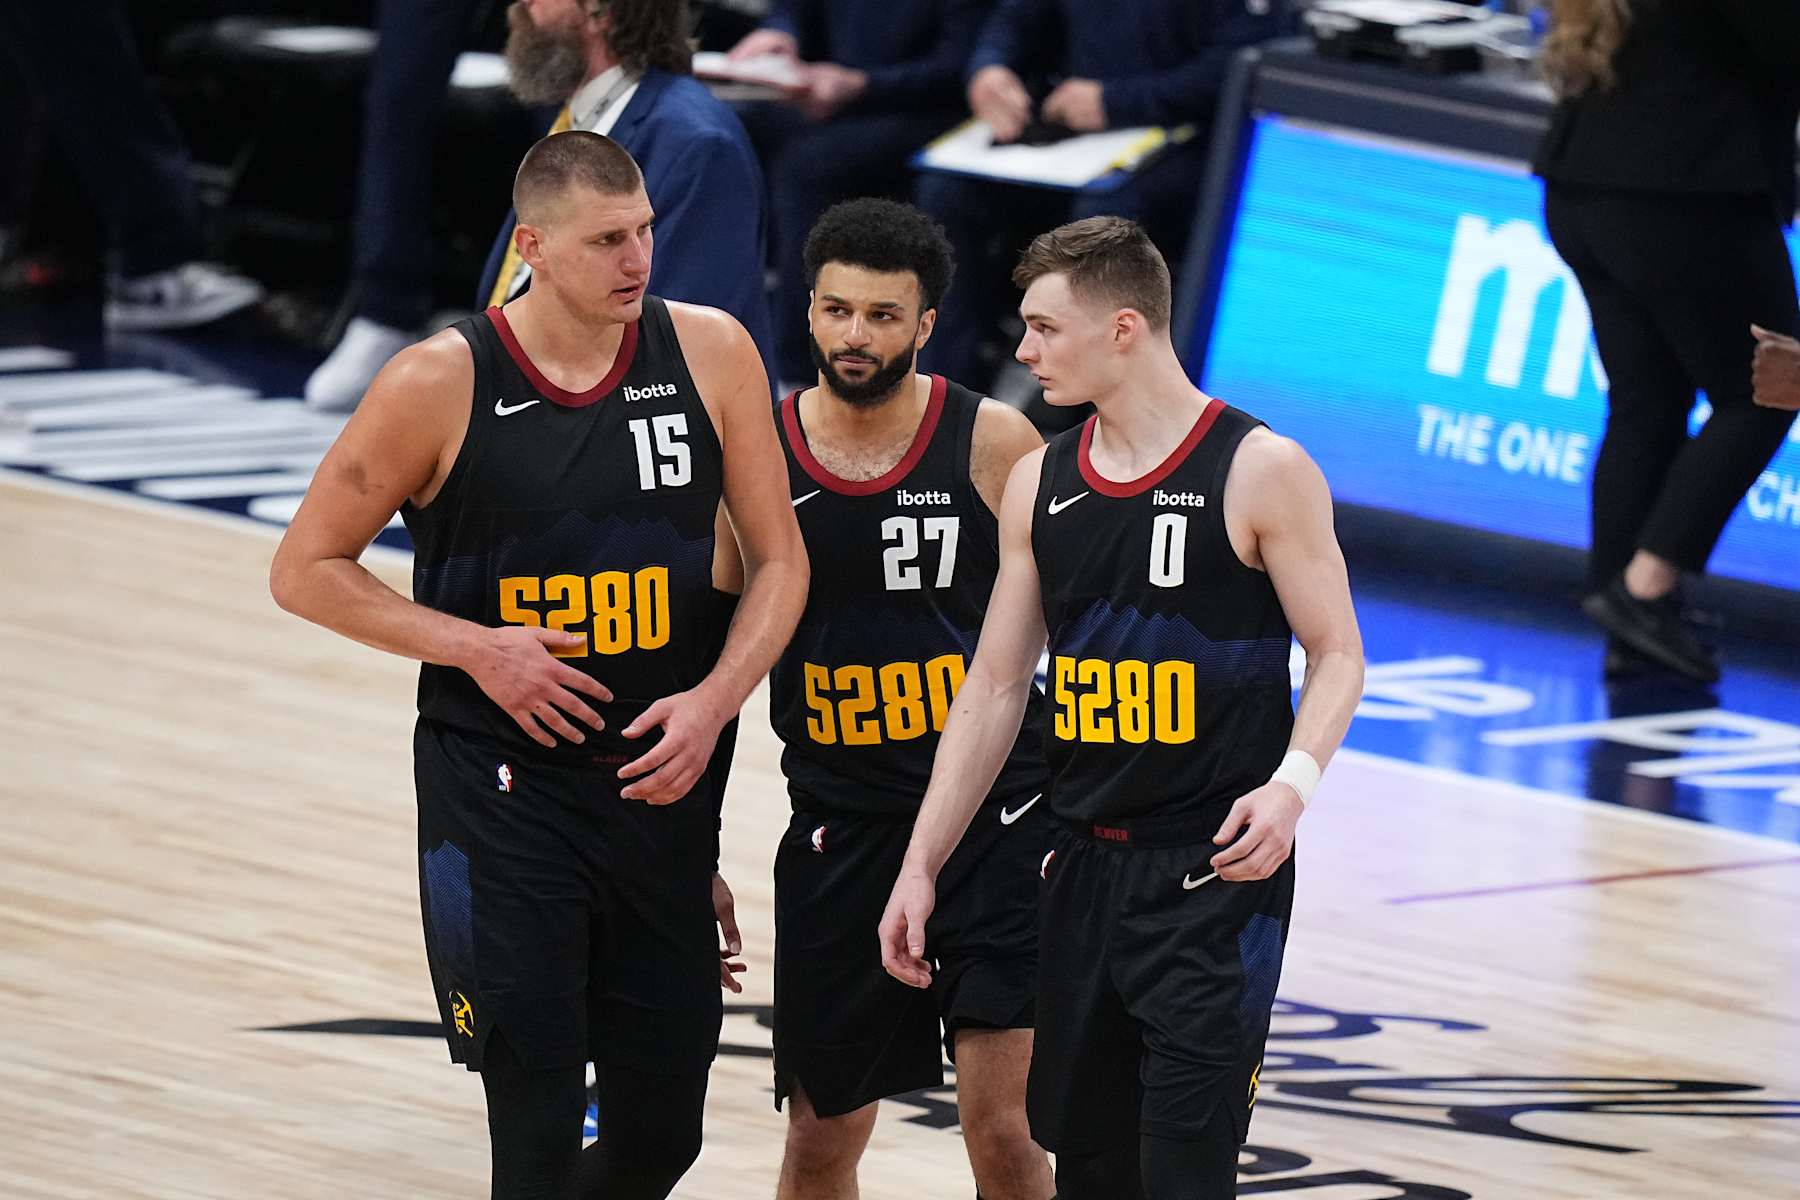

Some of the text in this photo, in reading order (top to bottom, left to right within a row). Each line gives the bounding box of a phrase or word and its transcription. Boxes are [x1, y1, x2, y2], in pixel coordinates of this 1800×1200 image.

[623, 383, 677, 402] ibotta
[628, 412, 692, 490] 15
[1418, 403, 1590, 484] THE ONE
[896, 489, 951, 506] ibotta
[1153, 489, 1205, 507] ibotta
[881, 516, 960, 590] 27
[1149, 513, 1188, 588] 0
[499, 566, 671, 658] 5280
[804, 653, 966, 745] 5280
[1055, 655, 1196, 744] 5280
